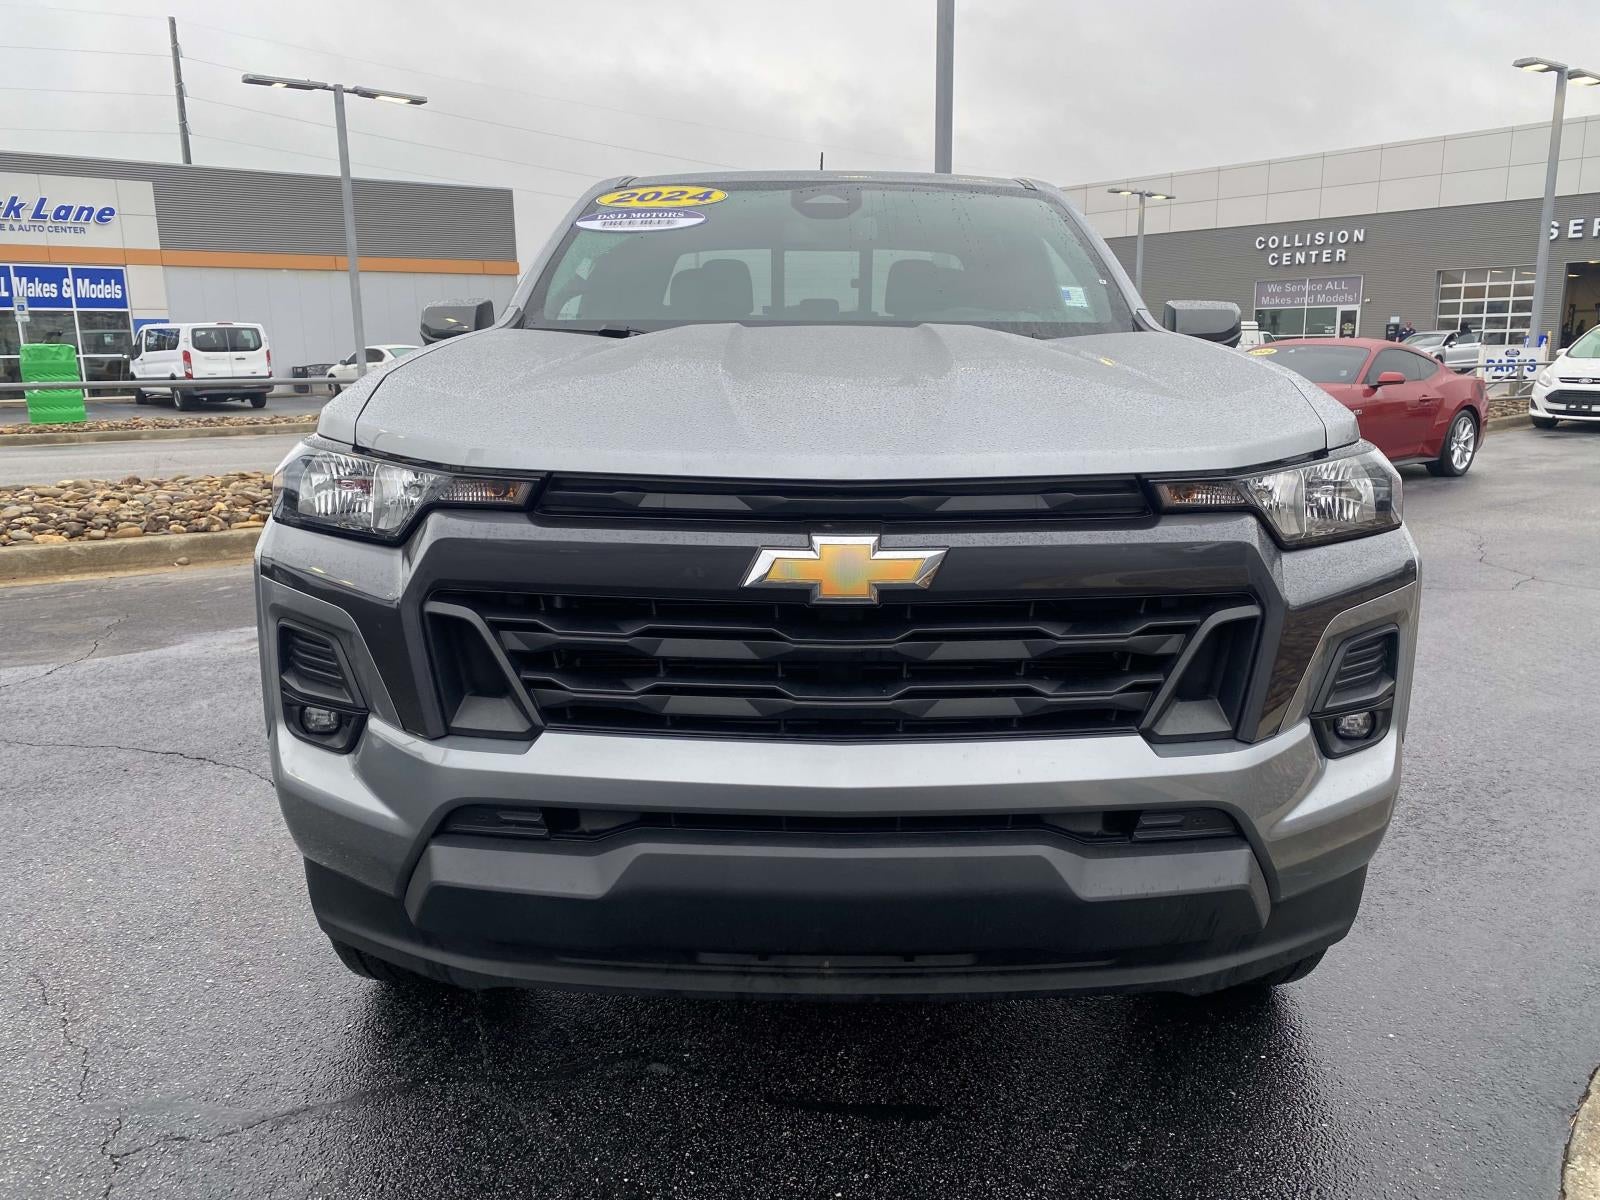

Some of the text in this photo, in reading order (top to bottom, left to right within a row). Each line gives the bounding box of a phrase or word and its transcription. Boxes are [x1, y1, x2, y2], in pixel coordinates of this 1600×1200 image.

[609, 190, 716, 204] 2024
[0, 195, 117, 225] k Lane
[630, 211, 685, 219] MOTORS
[18, 224, 45, 233] AUTO
[47, 225, 86, 234] CENTER
[1255, 228, 1365, 250] COLLISION
[1268, 249, 1347, 266] CENTER
[12, 276, 58, 298] Makes
[62, 277, 73, 298] &
[76, 278, 122, 299] Models
[1267, 280, 1349, 293] We Service ALL
[1261, 291, 1357, 305] Makes and Models!
